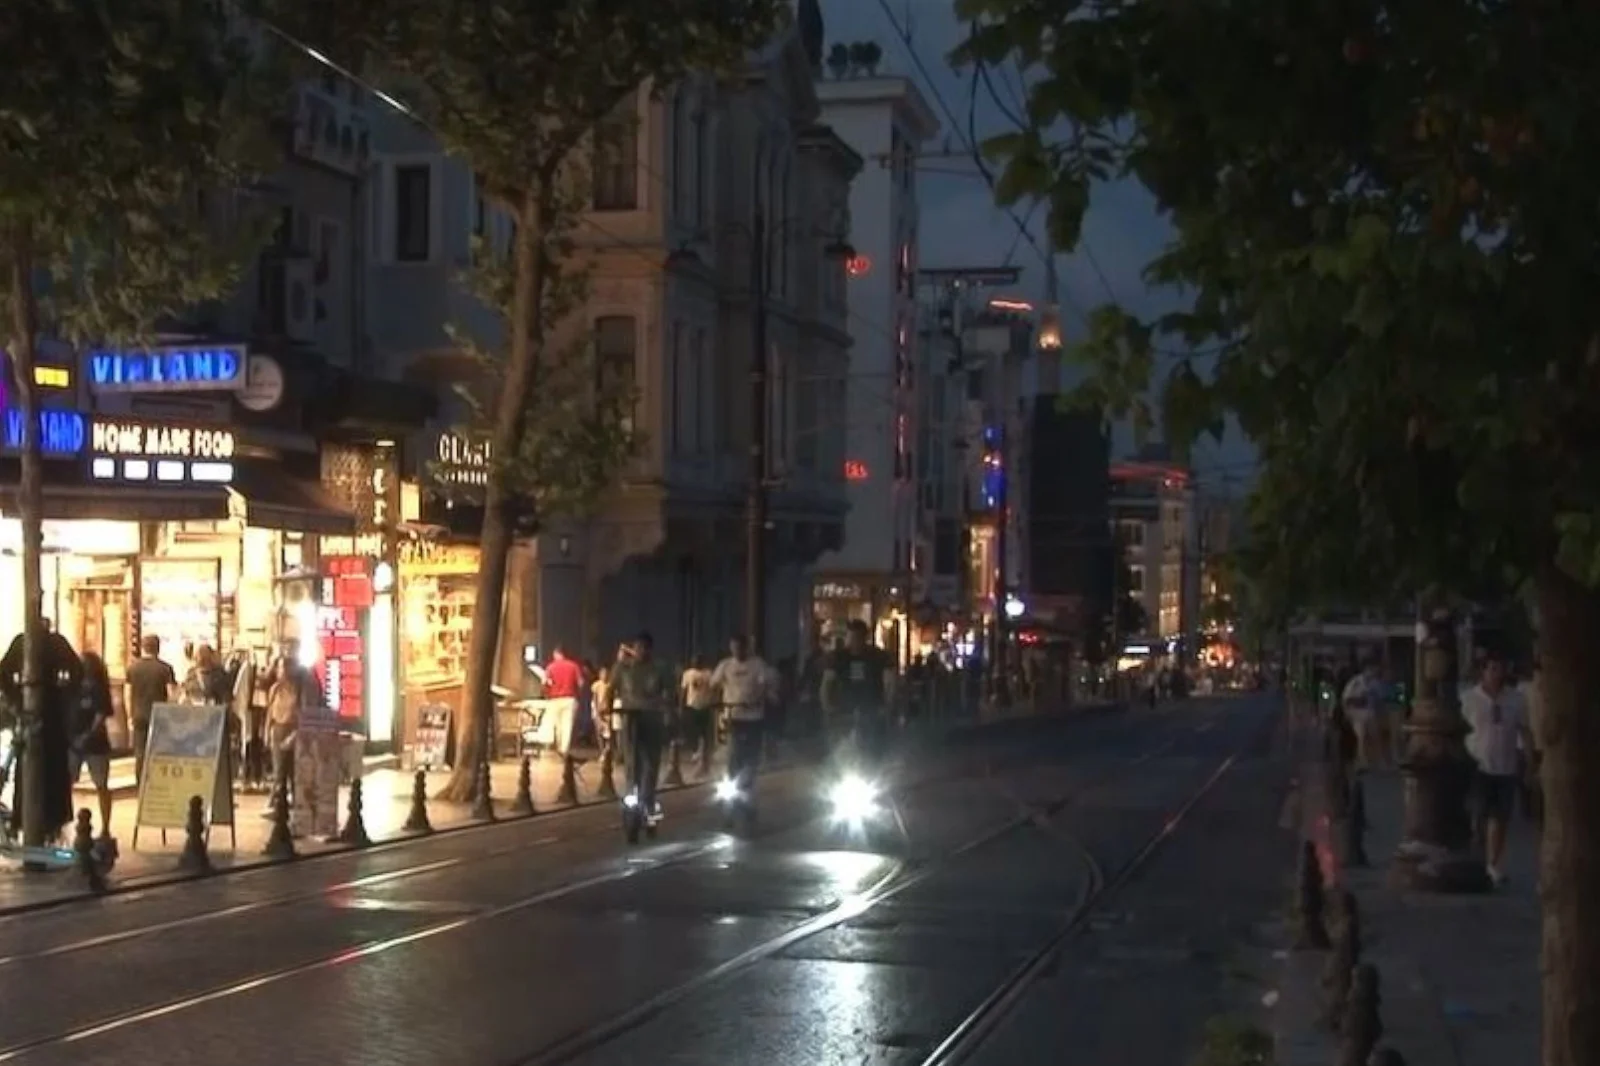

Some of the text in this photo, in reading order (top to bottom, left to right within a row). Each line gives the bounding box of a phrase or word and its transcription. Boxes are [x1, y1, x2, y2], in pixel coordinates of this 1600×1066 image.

[92, 422, 235, 458] HOME MADE FOOD
